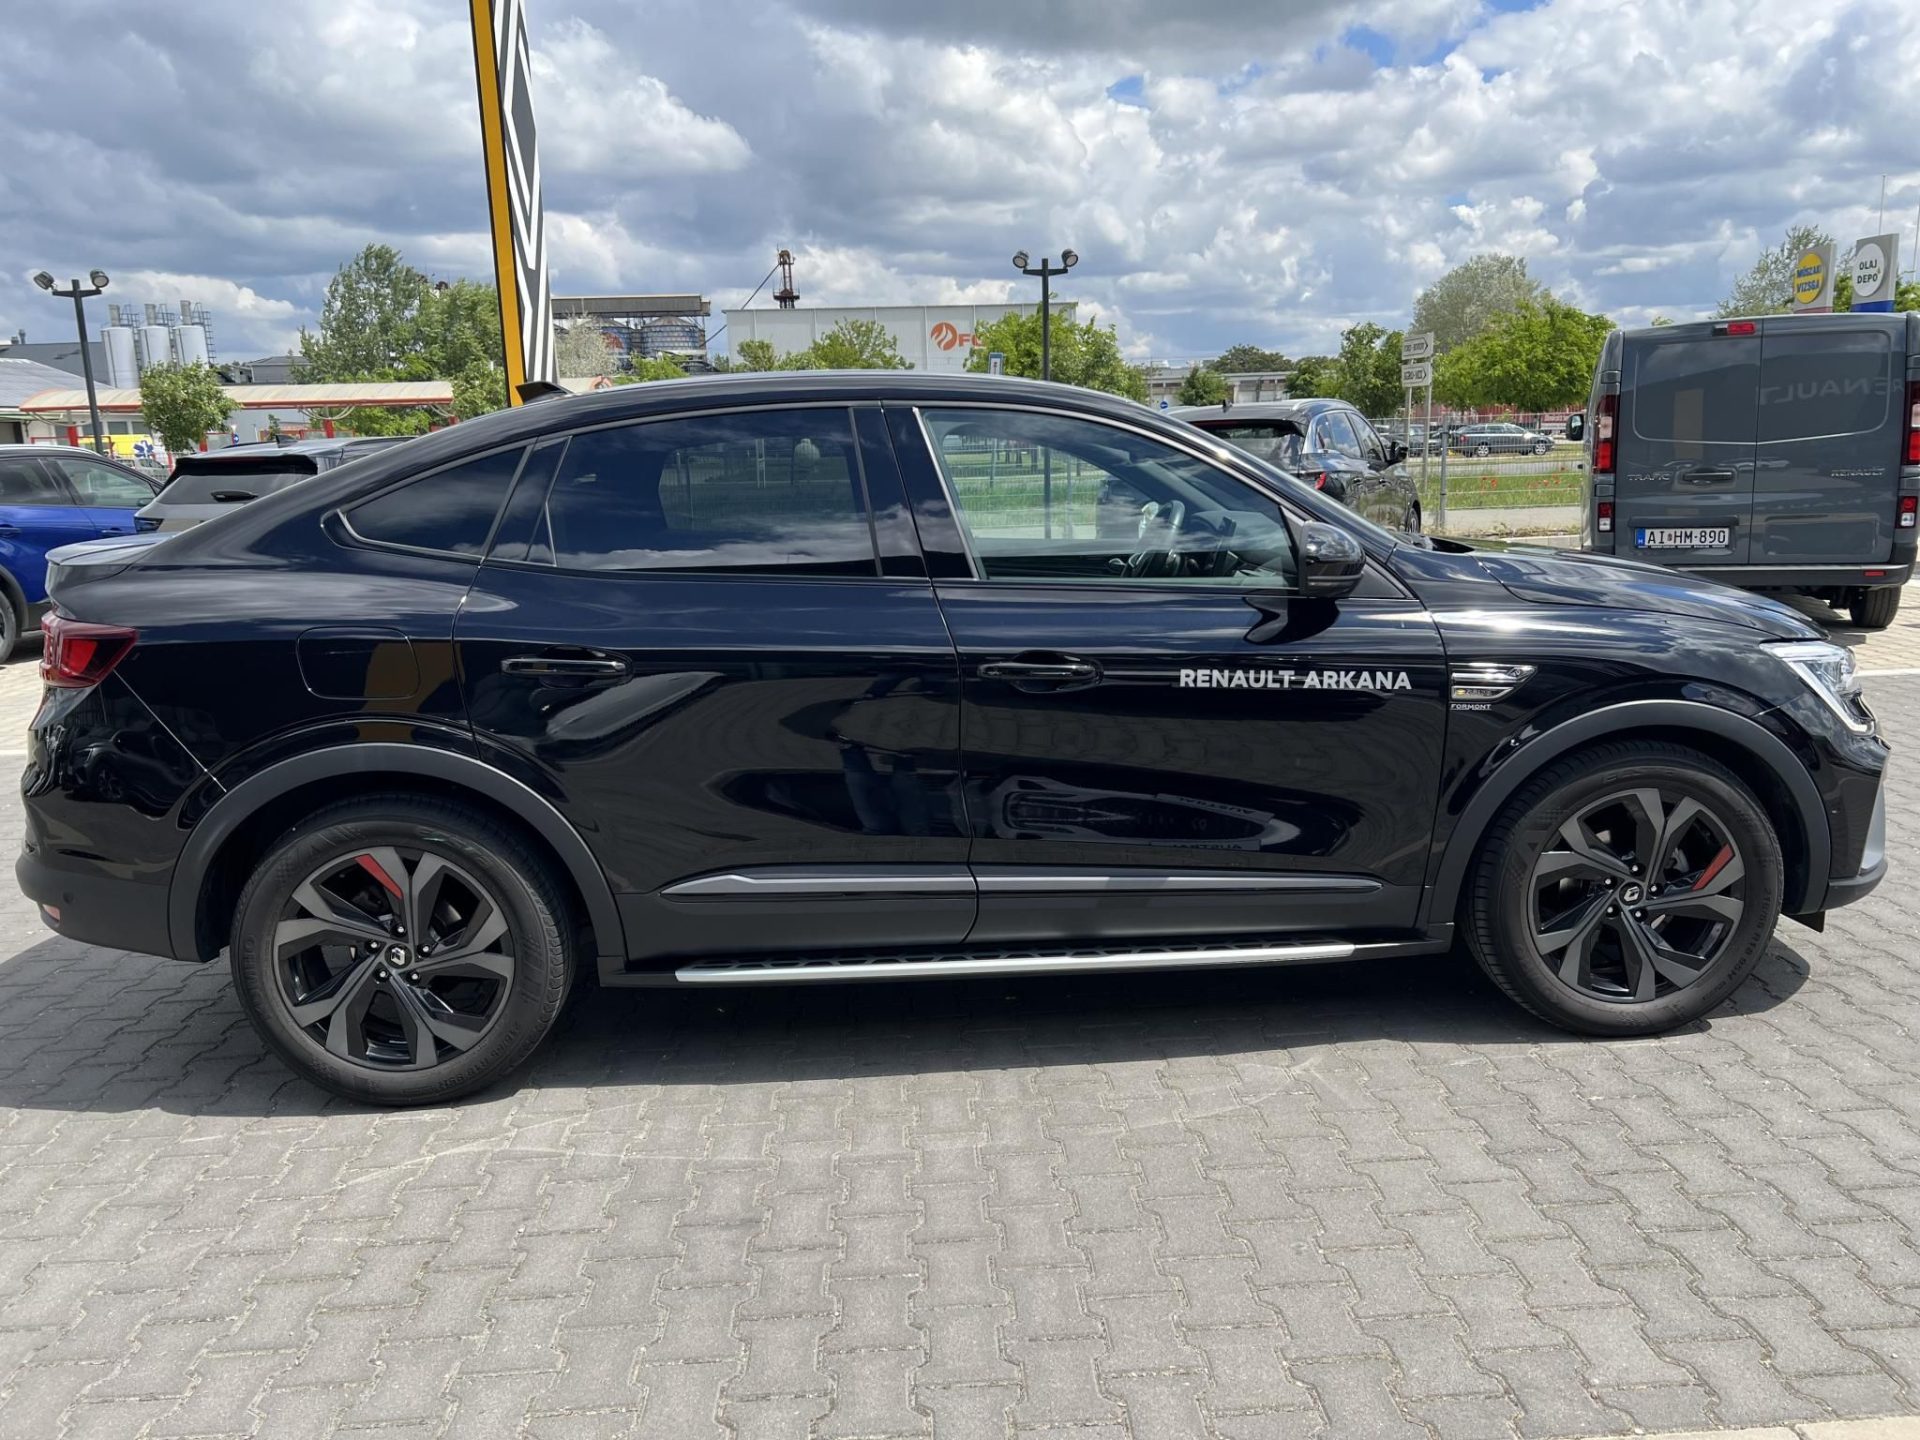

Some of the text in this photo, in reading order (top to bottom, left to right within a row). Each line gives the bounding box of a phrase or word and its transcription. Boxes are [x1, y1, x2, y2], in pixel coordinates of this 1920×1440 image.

[1859, 259, 1878, 271] OLAJ
[1627, 472, 1670, 481] TRAFIC
[1179, 668, 1412, 690] RENAULT ARKANA
[1450, 703, 1492, 711] FORMONT
